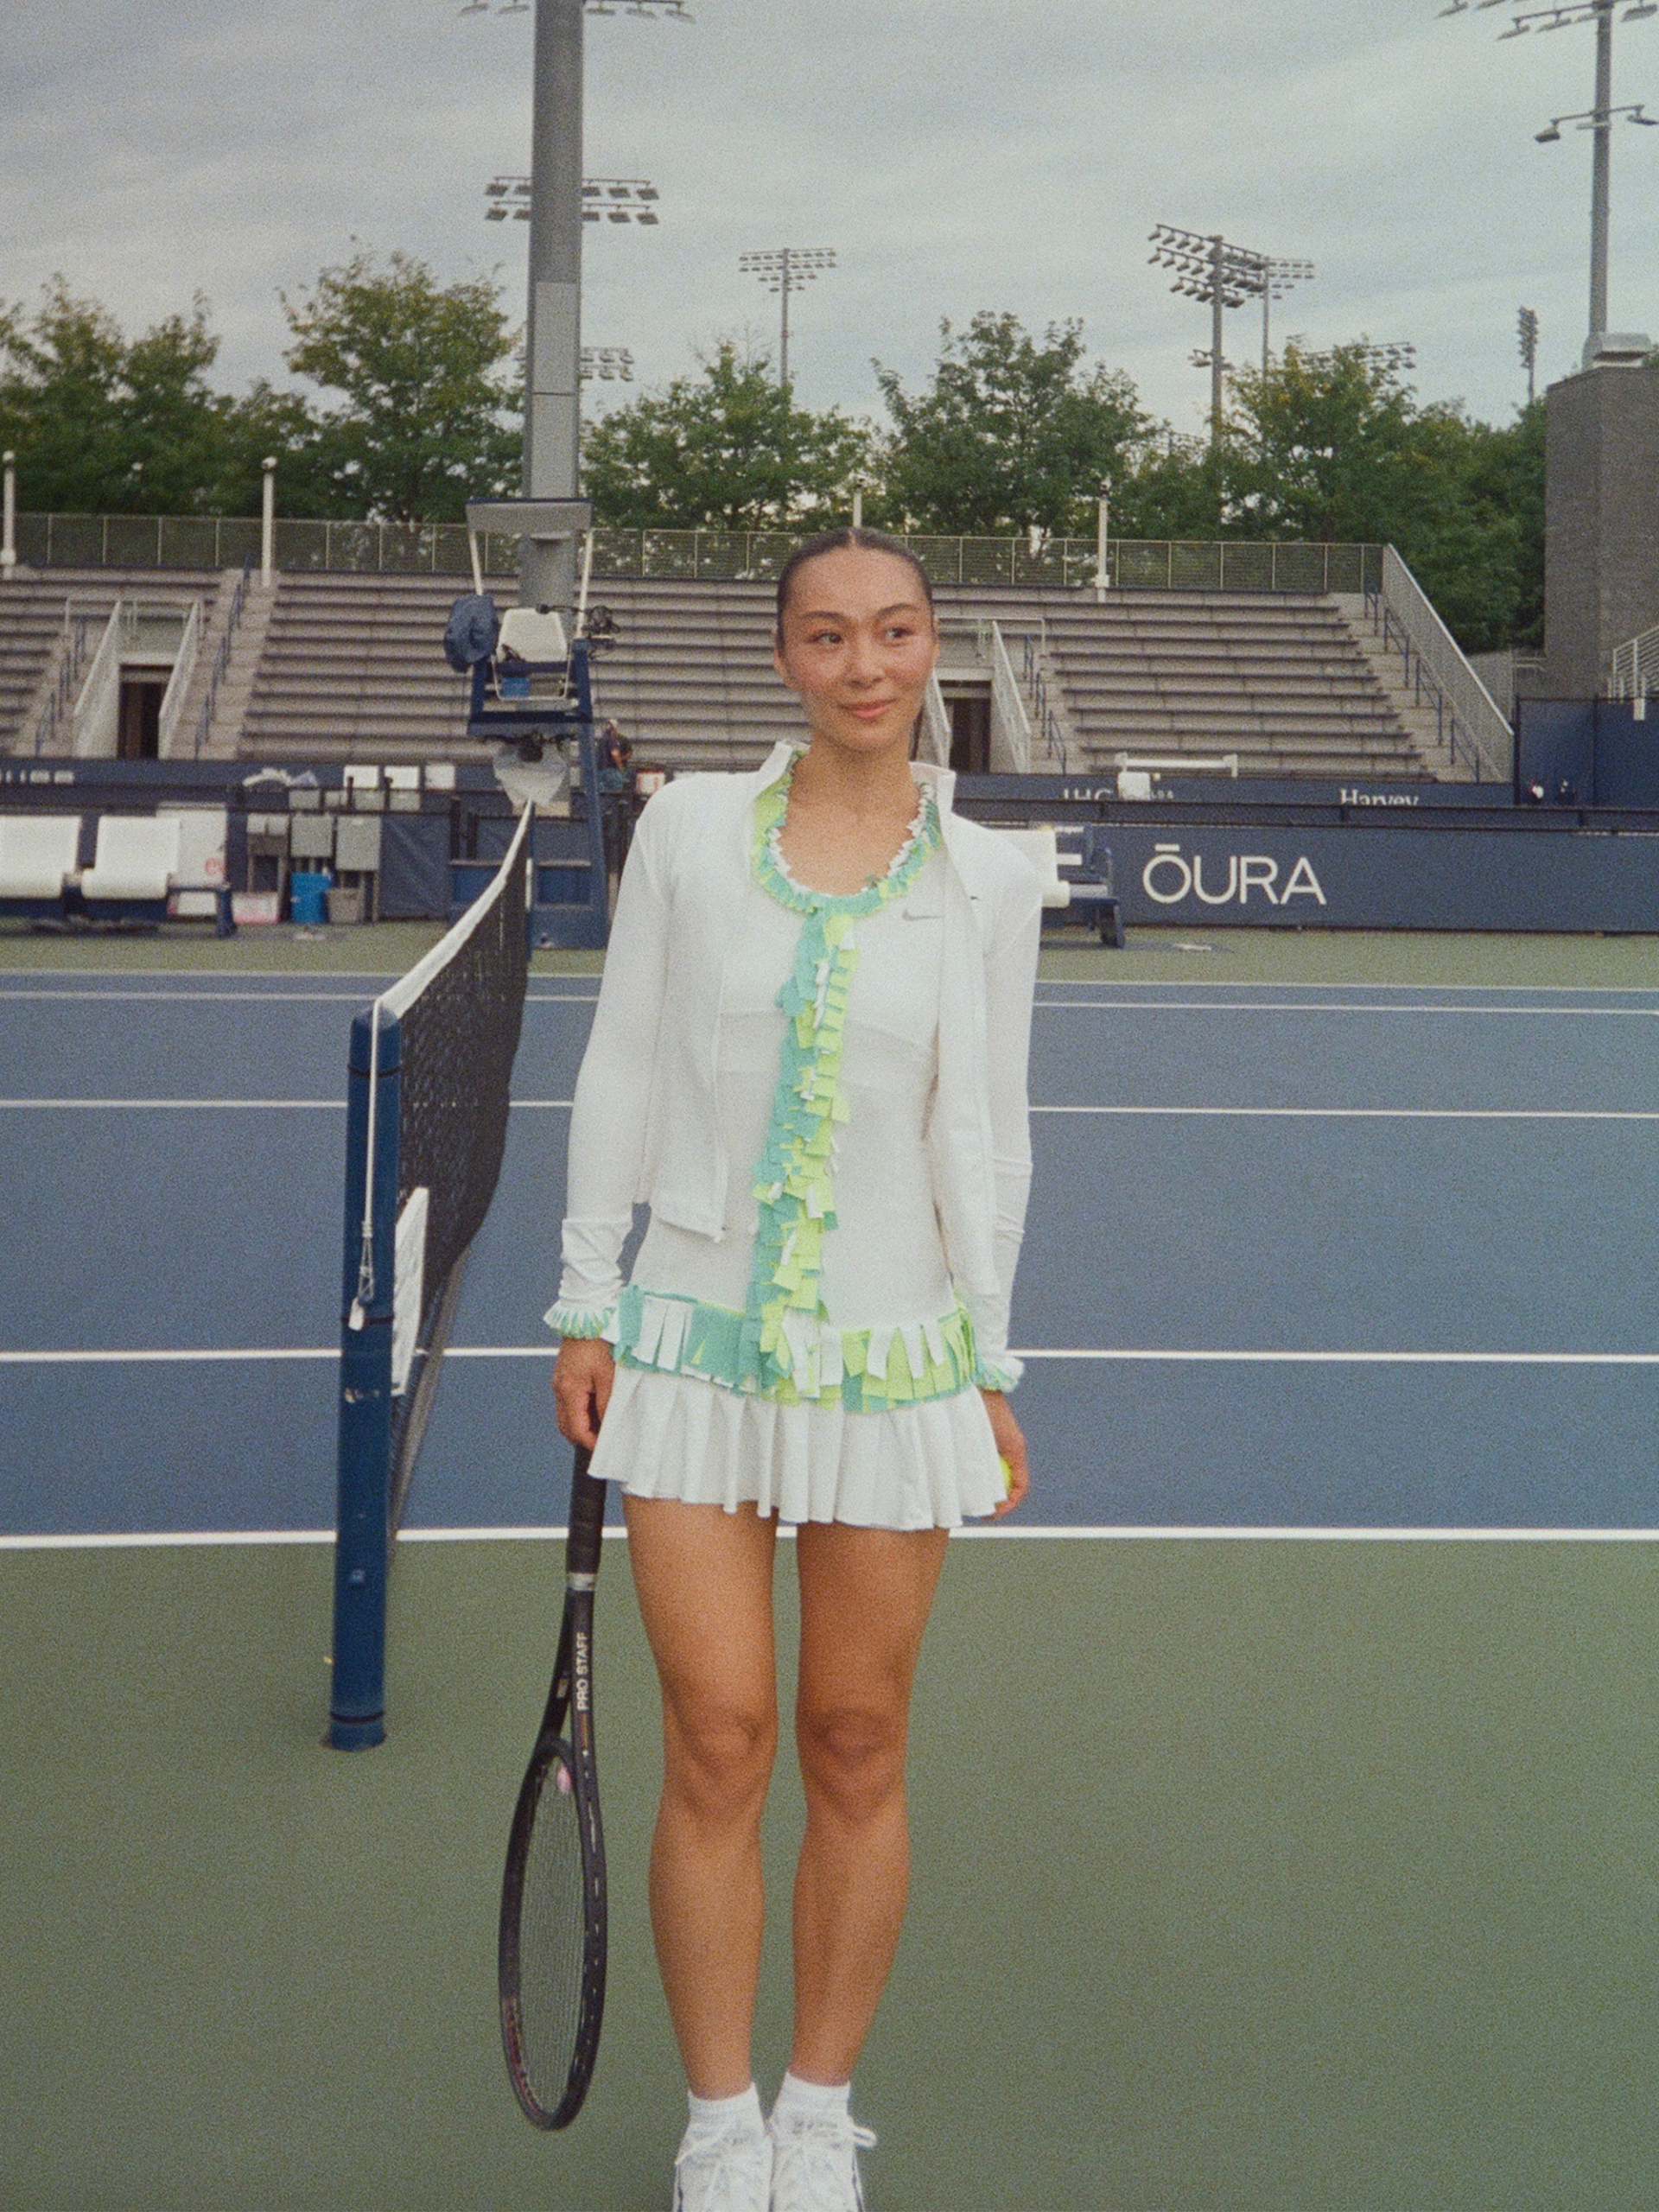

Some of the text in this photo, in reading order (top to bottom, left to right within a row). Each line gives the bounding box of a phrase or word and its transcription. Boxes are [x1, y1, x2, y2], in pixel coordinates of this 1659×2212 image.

[1143, 843, 1326, 905] ŌURA
[576, 1631, 589, 1711] PRO STAFF
